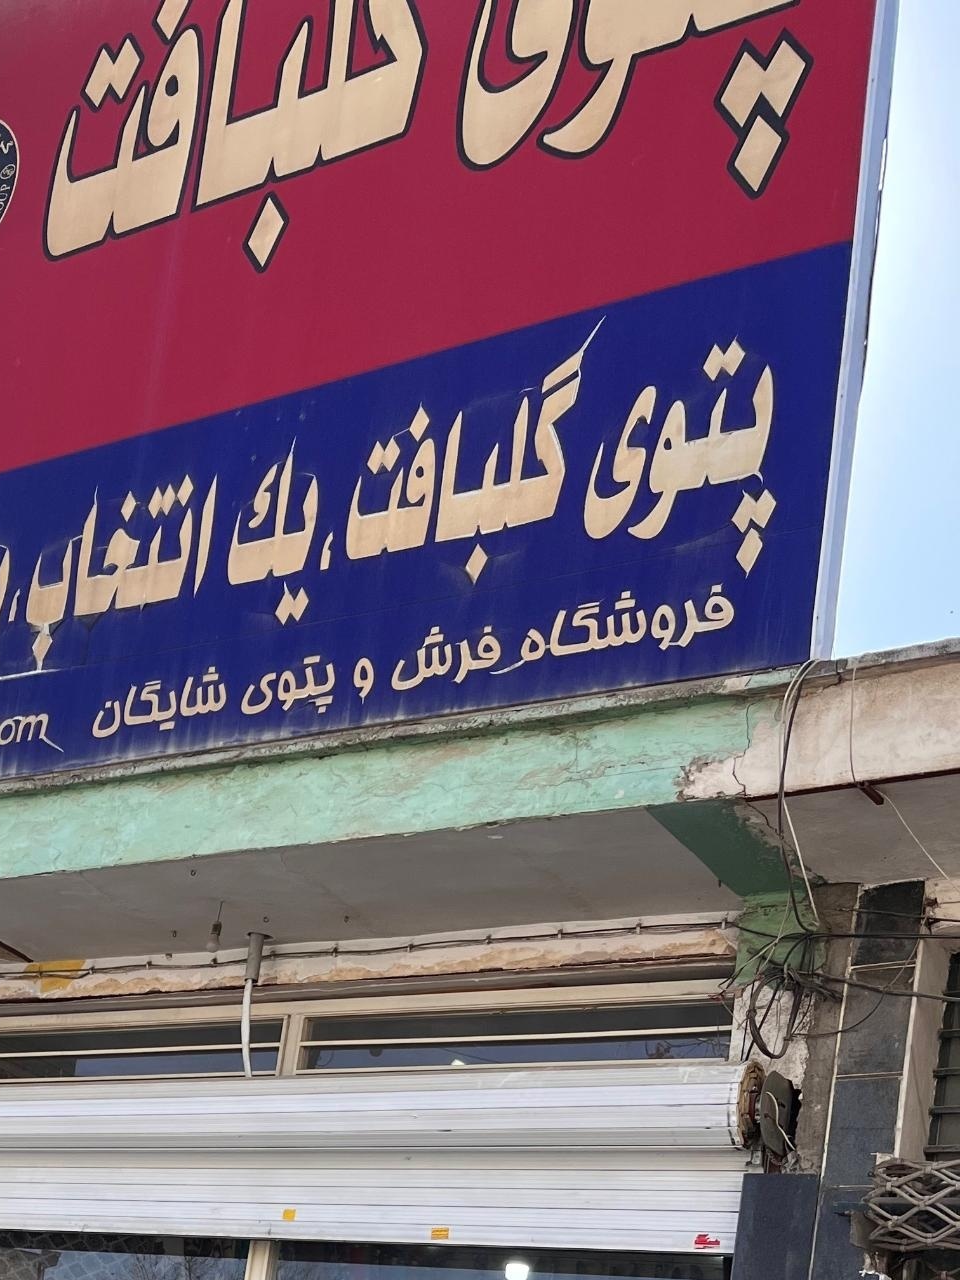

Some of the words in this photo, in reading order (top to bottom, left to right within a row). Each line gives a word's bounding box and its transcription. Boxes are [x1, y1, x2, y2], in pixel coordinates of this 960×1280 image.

[583, 337, 777, 575] پتوی
[390, 625, 503, 691] فرش
[520, 582, 736, 668] فروشگاه
[91, 666, 228, 739] شایگان
[240, 654, 336, 715] پتوی
[353, 656, 376, 700] و
